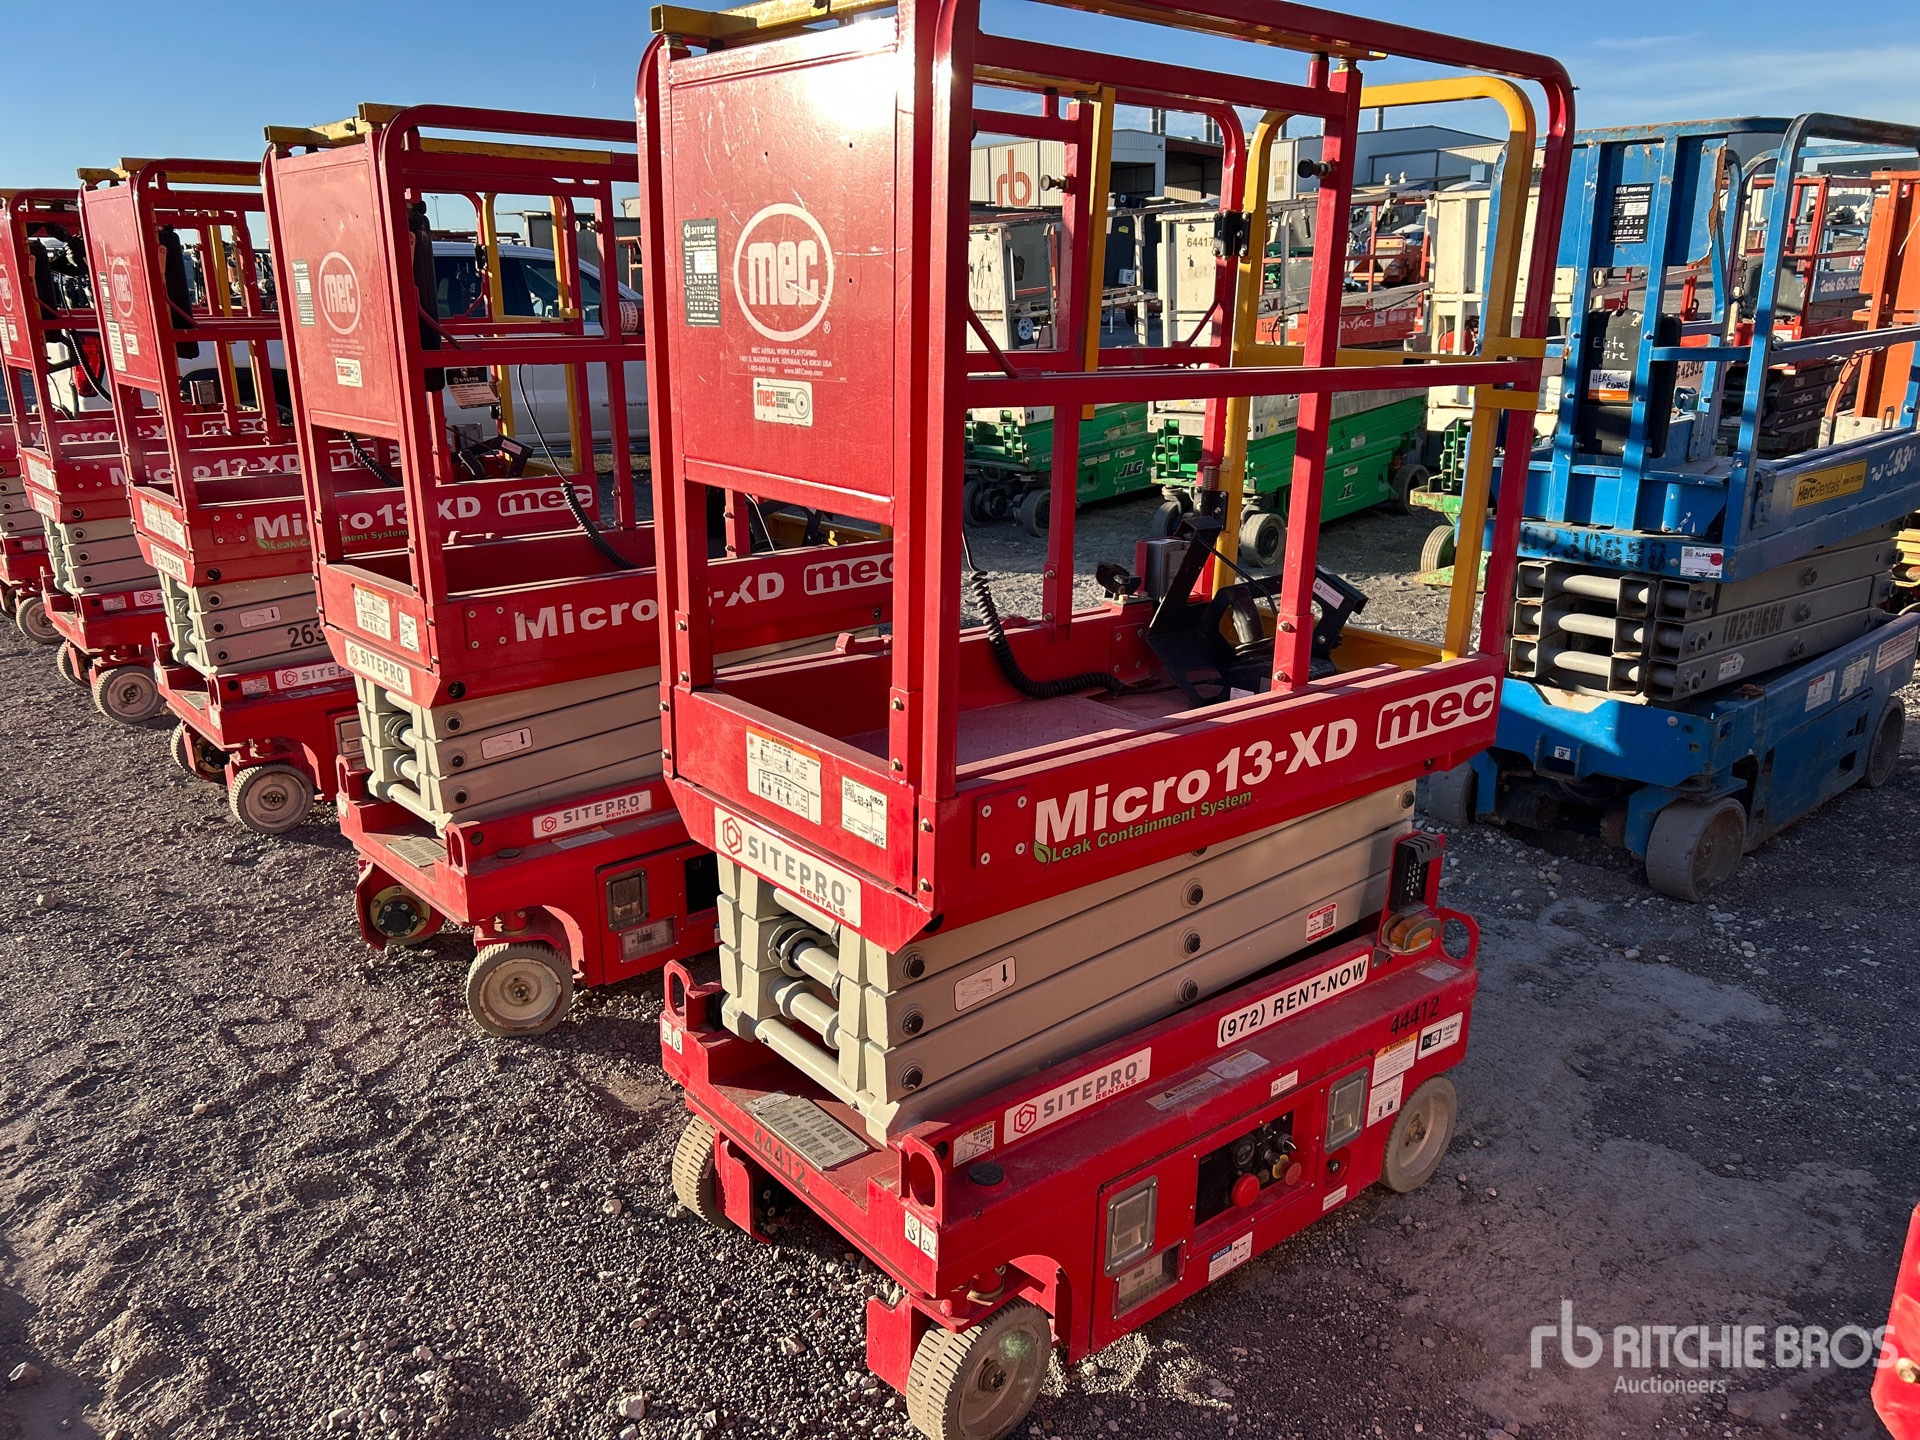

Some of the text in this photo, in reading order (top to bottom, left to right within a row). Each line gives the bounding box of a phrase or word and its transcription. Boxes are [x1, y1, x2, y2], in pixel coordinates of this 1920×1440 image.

[691, 226, 715, 235] SITEPRO
[1187, 237, 1214, 247] 64417
[748, 240, 819, 305] mec
[1593, 336, 1625, 348] Elite
[791, 349, 818, 357] PLATFORMS
[1602, 350, 1628, 361] Fire
[1593, 372, 1612, 384] HERC
[757, 389, 776, 407] mec
[1118, 460, 1144, 479] JLG
[271, 535, 297, 549] Leak
[371, 529, 408, 540] System
[360, 650, 404, 683] SITEPRO
[384, 676, 405, 691] RENTALS
[1380, 683, 1495, 746] mec
[564, 796, 639, 823] SITEPRO
[607, 807, 639, 819] RENTALS
[1052, 790, 1252, 862] Leak Containment System
[748, 835, 845, 906] SITEPRO
[800, 885, 846, 917] RENTALS
[1220, 961, 1366, 1042] (972) RENT-NOW
[1390, 995, 1440, 1034] 44412
[1389, 1036, 1411, 1051] WARNING
[1043, 1061, 1138, 1118] SITEPRO
[1095, 1078, 1137, 1100] RENTALS
[1173, 1078, 1201, 1093] WARNING
[973, 1125, 993, 1136] MAXIMUM
[980, 1130, 993, 1139] DOWN
[980, 1134, 993, 1143] ANGLE
[753, 1129, 806, 1189] 44412
[1212, 1246, 1231, 1260] NOTICE
